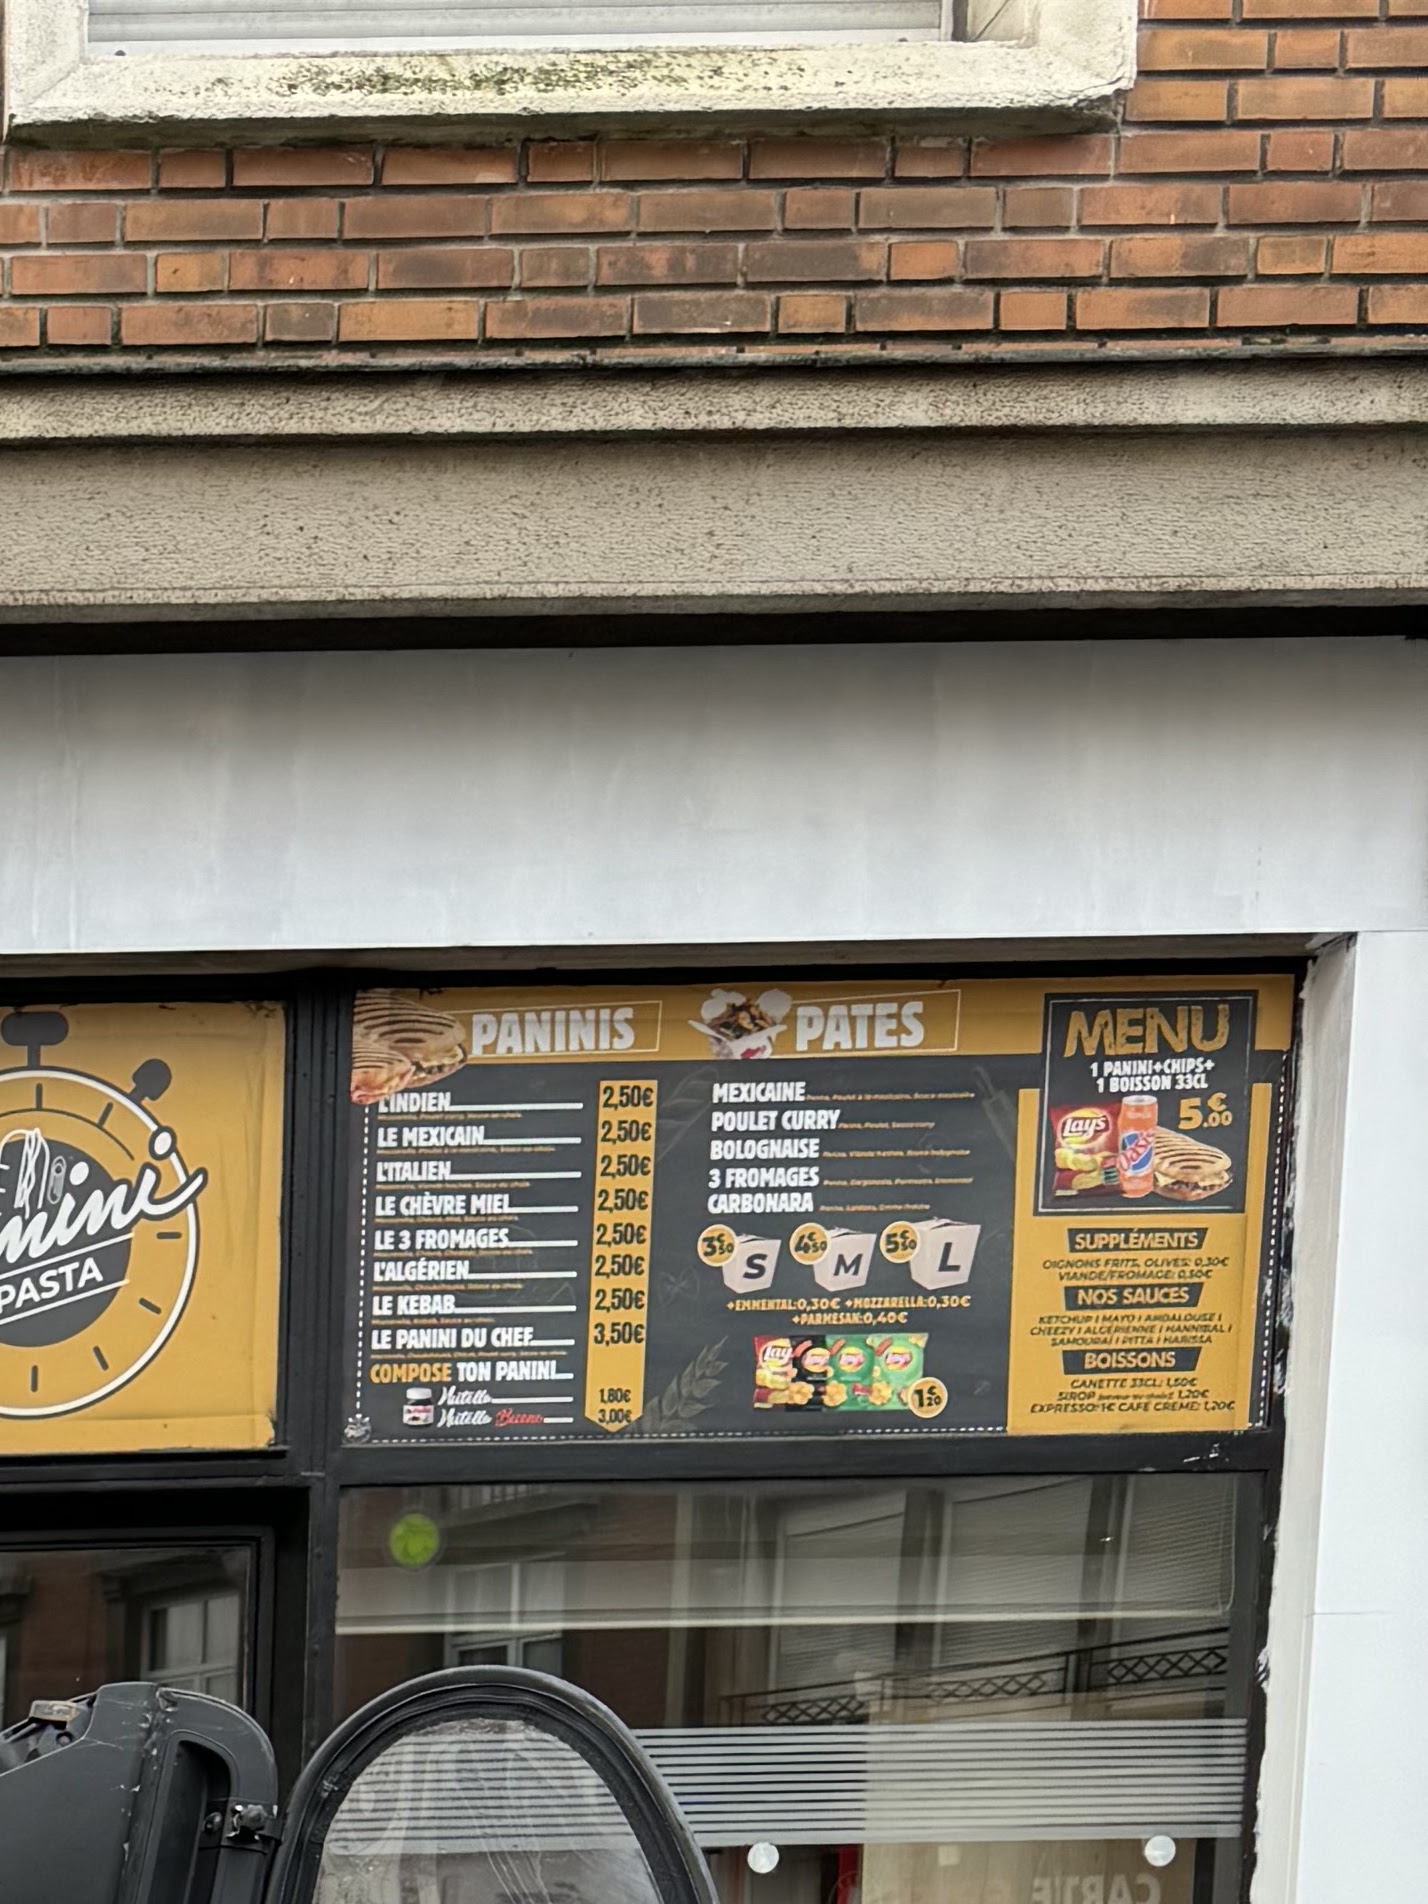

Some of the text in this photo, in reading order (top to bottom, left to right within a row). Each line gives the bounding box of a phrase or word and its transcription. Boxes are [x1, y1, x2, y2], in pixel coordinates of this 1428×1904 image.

[472, 1007, 635, 1055] PANINIS
[795, 1001, 924, 1051] PATES
[1064, 1004, 1230, 1057] MENU
[1090, 1062, 1098, 1077] 1
[712, 1082, 806, 1103] MEXICAINE
[1096, 1074, 1208, 1093] 1 BOISSON 33CL
[602, 1085, 654, 1108] 2,50€
[600, 1120, 652, 1142] 2,50€
[711, 1109, 841, 1131] POULET CURRY
[377, 1126, 485, 1147] LE MEXICAIN
[710, 1138, 820, 1160] BOLOGNAISE
[376, 1161, 452, 1182] L'ITALIEN
[600, 1154, 651, 1176] 2,50€
[708, 1169, 721, 1188] 3
[725, 1167, 820, 1188] FROMAGES
[375, 1191, 510, 1217] LE CHÈVRE MIEL
[597, 1188, 648, 1211] 2,50€
[708, 1192, 814, 1214] CARBONARA
[375, 1228, 510, 1250] LE 3 FROMAGES
[596, 1222, 647, 1245] 2,50€
[1075, 1229, 1198, 1249] SUPPLÉMENTS
[594, 1255, 646, 1277] 2,50€
[743, 1254, 767, 1279] S
[833, 1253, 863, 1276] M
[938, 1241, 961, 1272] L
[372, 1294, 456, 1316] LE KEBAB
[594, 1288, 646, 1311] 2,50€
[1077, 1287, 1189, 1305] NOS SAUCES
[372, 1327, 534, 1350] LE PANINI DU CHEF
[594, 1322, 645, 1345] 3,50€
[370, 1360, 557, 1383] COMPOSE TON PANINI
[1084, 1352, 1176, 1370] BOISSONS
[599, 1388, 631, 1403] 1,80€
[598, 1408, 631, 1424] 3,00€
